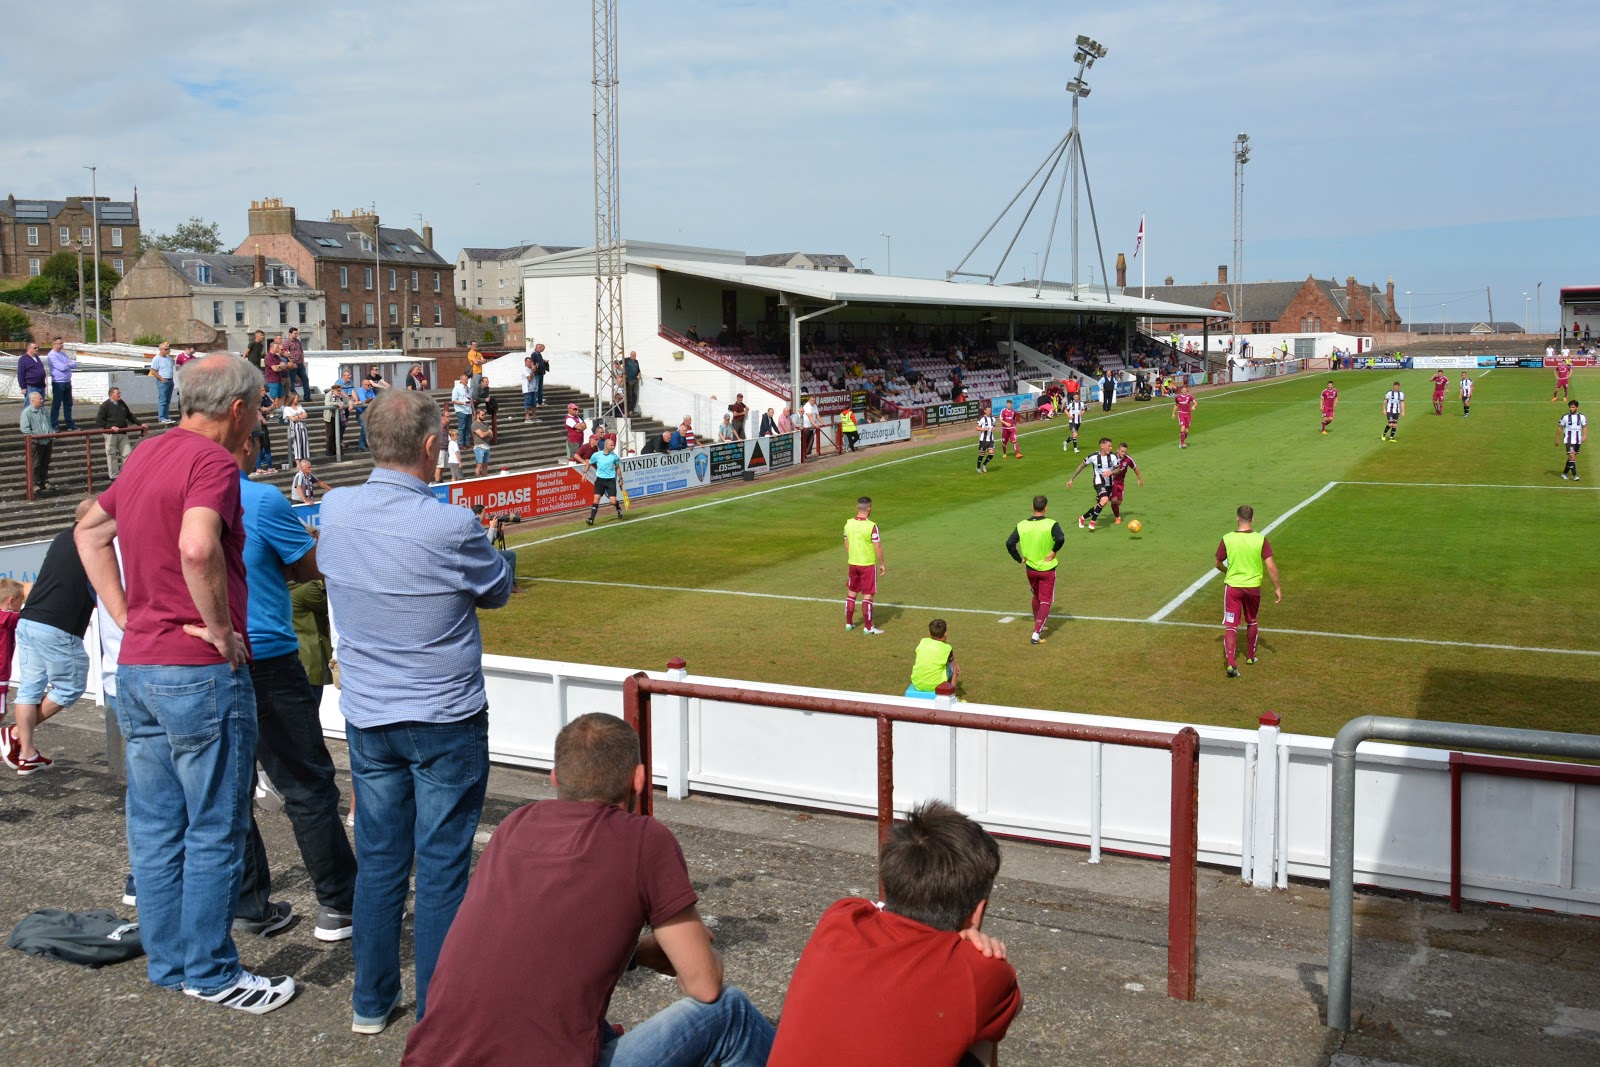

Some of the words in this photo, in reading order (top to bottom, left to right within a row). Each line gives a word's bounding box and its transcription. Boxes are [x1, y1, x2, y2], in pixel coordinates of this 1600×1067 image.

[676, 297, 682, 310] A
[820, 396, 843, 404] ARBROATH
[858, 425, 895, 444] pfltrust.org.uk
[622, 457, 658, 472] TAYSIDE
[660, 453, 690, 466] GROUP
[719, 464, 728, 472] £35
[668, 481, 686, 489] MAINTAIN
[536, 488, 560, 496] ARBROATH
[459, 488, 531, 508] BUILDBASE
[542, 496, 558, 504] 01241
[536, 498, 586, 513] www.buildbase.co.uk
[509, 506, 530, 514] SUPPLIES
